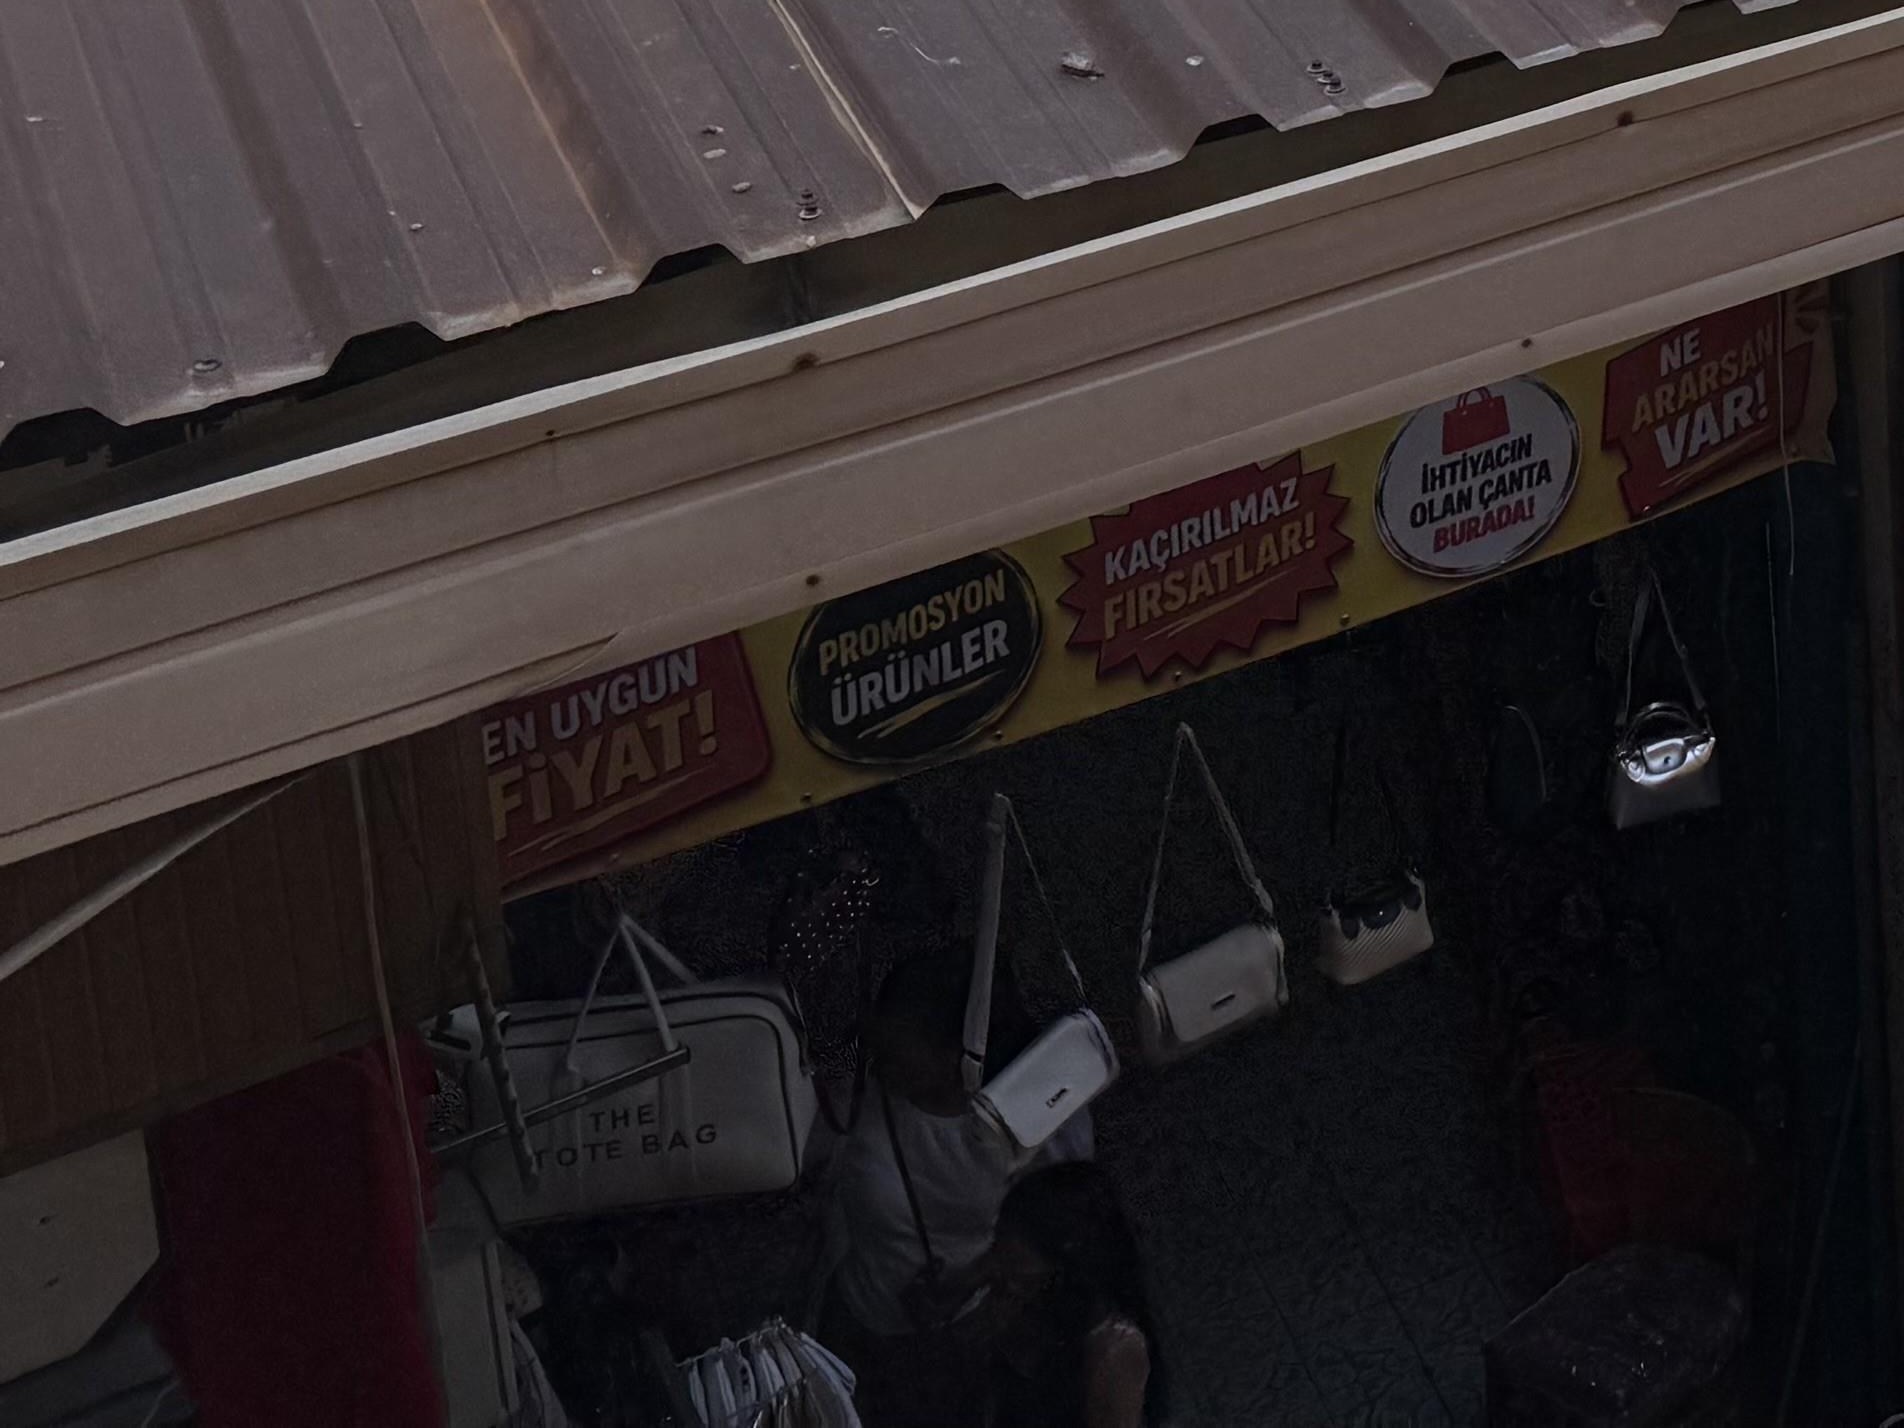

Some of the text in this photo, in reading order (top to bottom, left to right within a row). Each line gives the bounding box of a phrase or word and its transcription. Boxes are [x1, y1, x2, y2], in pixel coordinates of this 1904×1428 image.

[1631, 319, 1776, 426] ARARSAN
[1660, 327, 1702, 377] NE
[1420, 433, 1534, 496] İHTİYACIN
[1654, 366, 1769, 471] VAR!
[1103, 477, 1301, 584] KAÇIRILMAZ
[1410, 458, 1553, 530] OLAN ÇANTA
[1432, 495, 1537, 554] BURADA!
[817, 568, 1008, 678] PROMOSYON
[1101, 518, 1317, 643] FIRSATLAR!
[481, 646, 700, 767] EN UYGUN
[830, 618, 1011, 727] ÜRÜNLER
[487, 689, 719, 842] FİYAT!
[534, 1123, 717, 1169] TOTE BAG
[589, 1103, 656, 1133] THE
